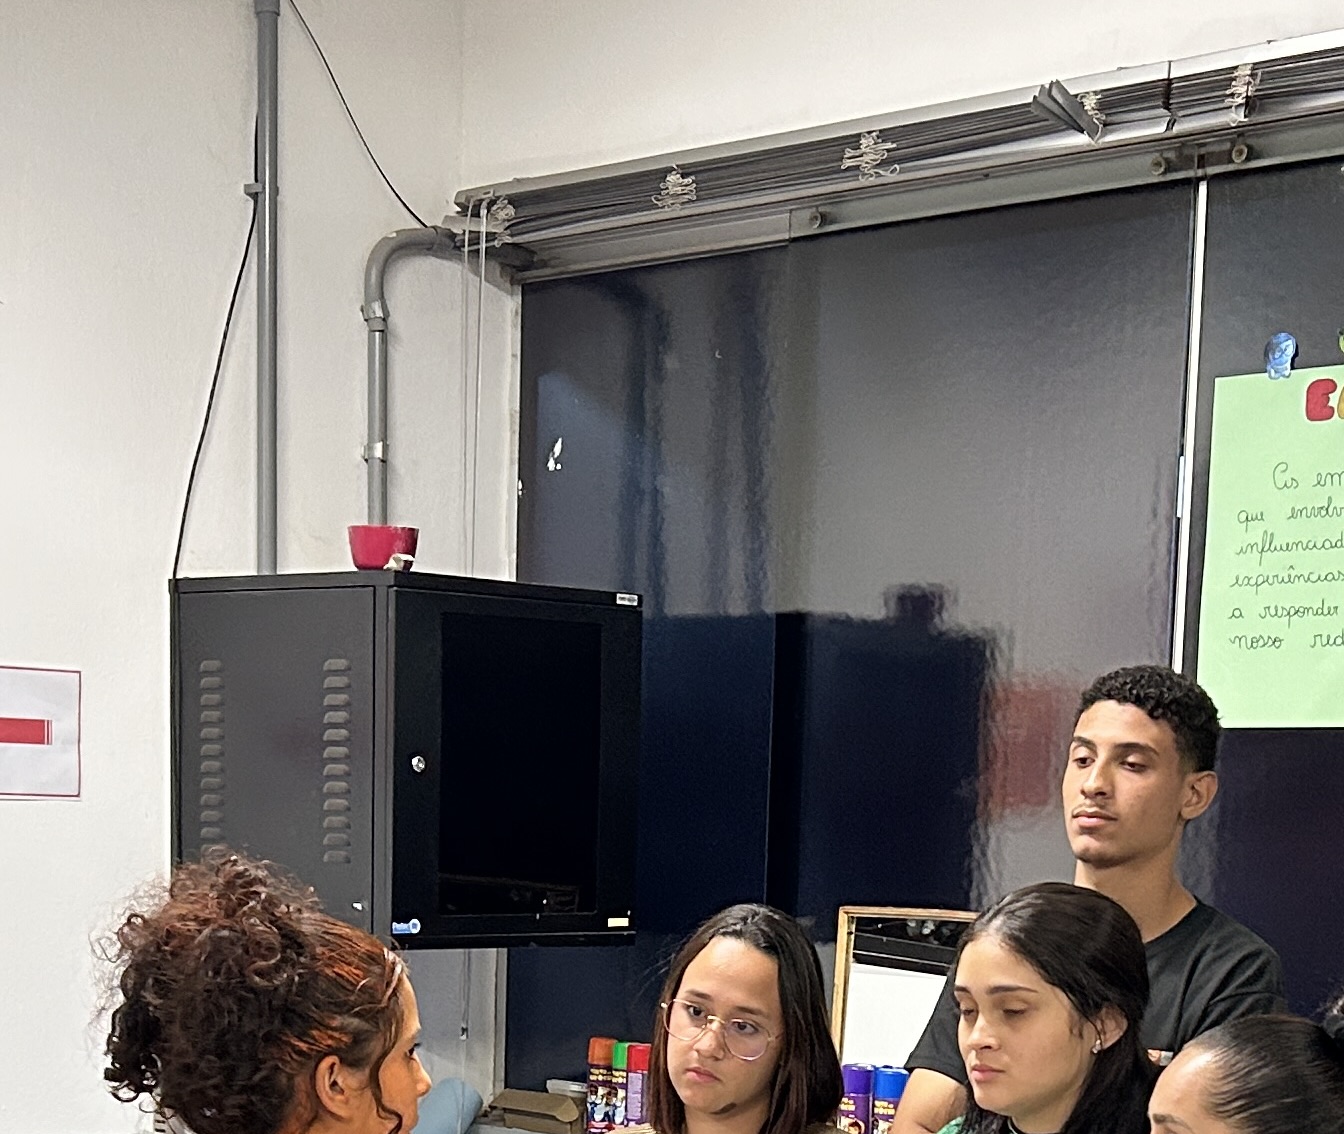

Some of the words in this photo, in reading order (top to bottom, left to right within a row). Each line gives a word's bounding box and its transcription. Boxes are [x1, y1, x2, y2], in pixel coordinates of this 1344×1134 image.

[1272, 461, 1300, 491] As
[1237, 509, 1266, 534] que
[1227, 606, 1246, 621] a
[1258, 598, 1340, 630] responder
[1228, 632, 1286, 651] nosso
